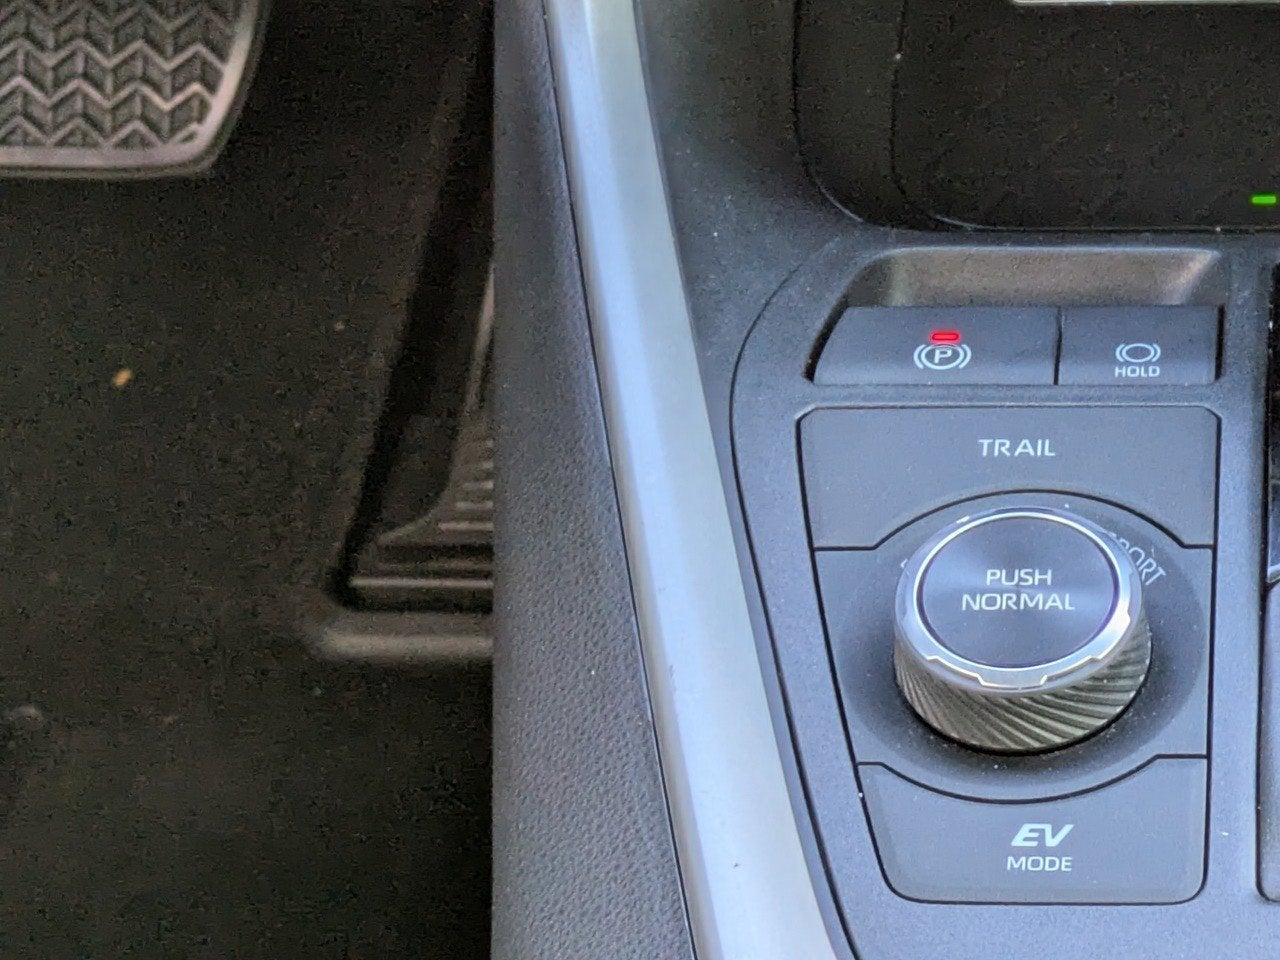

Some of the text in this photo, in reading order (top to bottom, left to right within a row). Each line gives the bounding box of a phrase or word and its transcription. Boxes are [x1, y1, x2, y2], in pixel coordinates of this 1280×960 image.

[1114, 364, 1161, 379] HOLD
[978, 438, 1056, 458] TRAIL
[986, 568, 1053, 587] PUSH
[961, 592, 1076, 612] NORMAL
[1010, 823, 1074, 847] EV
[1006, 855, 1072, 872] MODE
